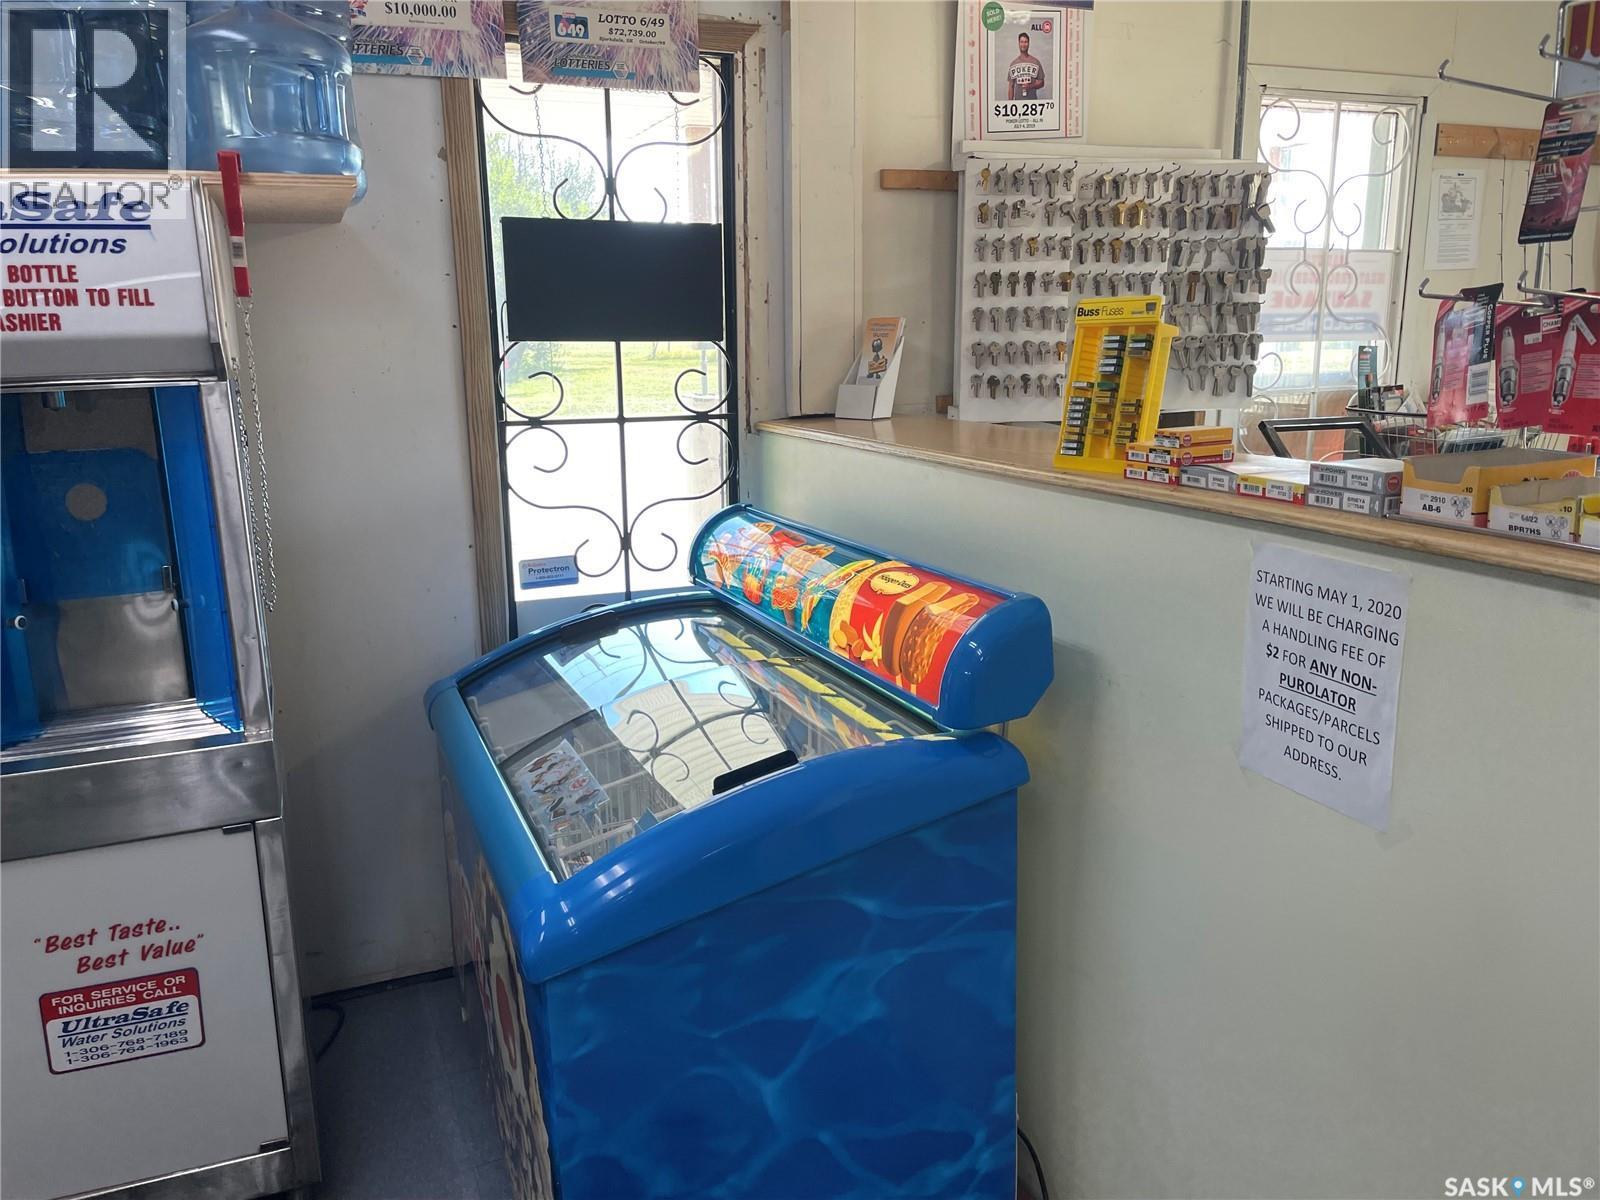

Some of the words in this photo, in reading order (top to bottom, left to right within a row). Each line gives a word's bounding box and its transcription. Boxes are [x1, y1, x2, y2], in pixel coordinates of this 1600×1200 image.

[384, 1, 457, 19] $10,000.00
[598, 13, 637, 26] LOTTO
[639, 17, 665, 29] 6/49
[608, 27, 657, 38] $72,739.00
[352, 42, 404, 56] TTERIES
[554, 57, 611, 71] LOTTERIES
[1011, 65, 1038, 77] POKER
[0, 190, 151, 222] Safe
[7, 264, 79, 284] BOTTLE
[2, 288, 79, 307] BUTTON
[86, 288, 111, 307] TO
[117, 287, 155, 307] FILL
[1077, 307, 1100, 318] Buss
[1101, 306, 1125, 317] Fuses
[1485, 303, 1494, 336] COPPER
[1482, 337, 1490, 359] PLUS
[1421, 503, 1442, 514] AB-6
[1508, 524, 1542, 536] BPR7HS
[528, 565, 570, 575] Protectron
[1256, 569, 1314, 597] STARTING
[1317, 586, 1347, 605] MAY
[1351, 594, 1363, 611] 1,
[1367, 599, 1402, 620] 2020
[1255, 593, 1274, 609] WE
[1277, 598, 1304, 619] WILL
[1307, 608, 1323, 625] BE
[1326, 614, 1399, 647] CHARGING
[1262, 619, 1270, 633] A
[1273, 623, 1337, 654] HANDLING
[1341, 644, 1363, 662] FEE
[1367, 652, 1386, 668] OF
[1265, 643, 1280, 661] $2
[1282, 649, 1307, 668] FOR
[1310, 658, 1338, 679] ANY
[1341, 667, 1377, 691] NON-
[1279, 672, 1357, 713] PUROLATOR
[1258, 688, 1381, 746] PACKAGES/PARCELS
[1265, 713, 1314, 744] SHIPPED
[1317, 734, 1334, 752] TO
[1337, 744, 1367, 766] OUR
[1283, 745, 1342, 781] ADDRESS.
[109, 917, 181, 943] Taste..
[77, 949, 130, 974] Best
[51, 993, 84, 1008] FOR
[91, 980, 158, 1001] SERVICE
[164, 975, 187, 988] OR
[58, 994, 137, 1016] INQUIRIES
[143, 986, 182, 1001] CALL
[61, 1000, 190, 1034] UltraSafe
[61, 1032, 108, 1049] Water
[111, 1017, 187, 1040] Solutions
[63, 1028, 189, 1058] 1-306-768-7189
[66, 1036, 189, 1065] 1-306-764-1963
